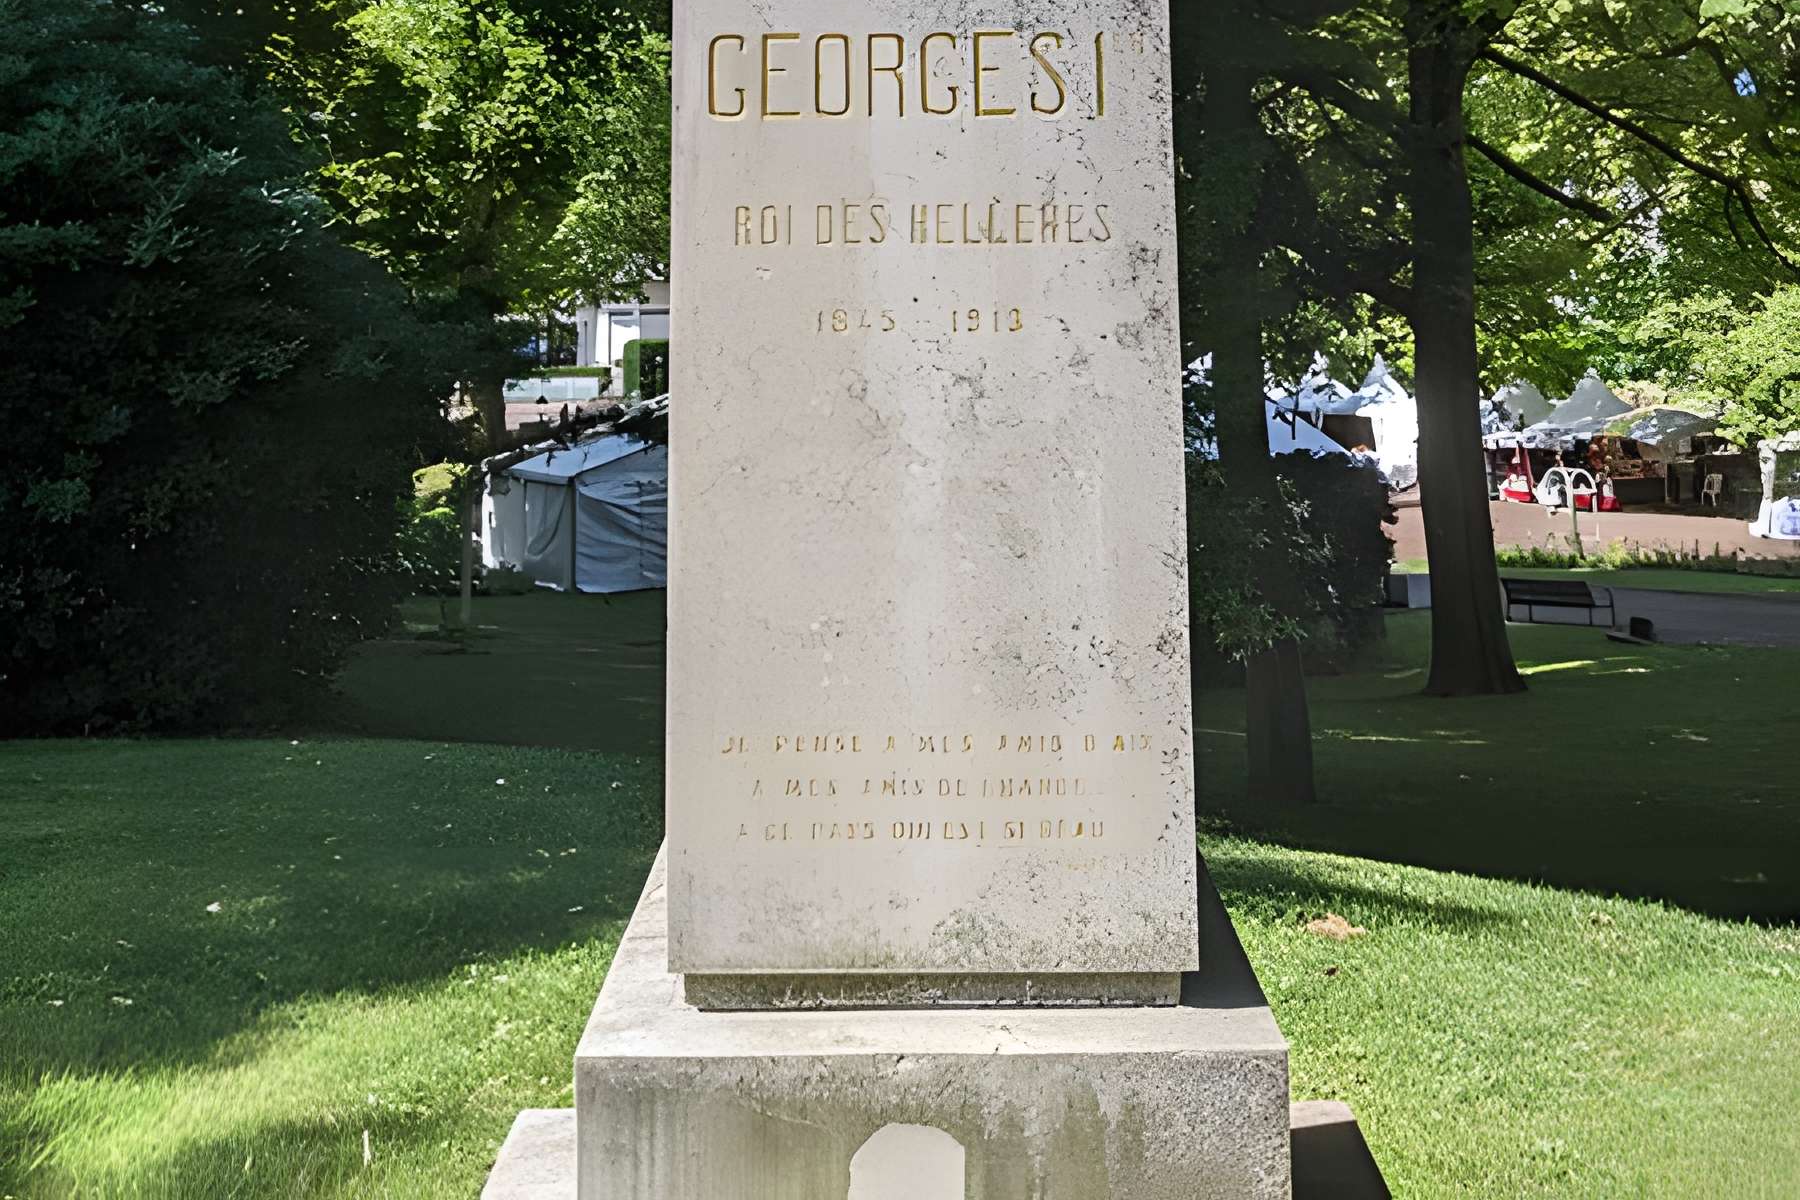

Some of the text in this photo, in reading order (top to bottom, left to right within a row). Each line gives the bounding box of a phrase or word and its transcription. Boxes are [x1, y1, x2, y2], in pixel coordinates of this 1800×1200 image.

[708, 31, 1065, 117] GEORGES
[735, 204, 792, 245] ROI
[816, 203, 888, 245] DES
